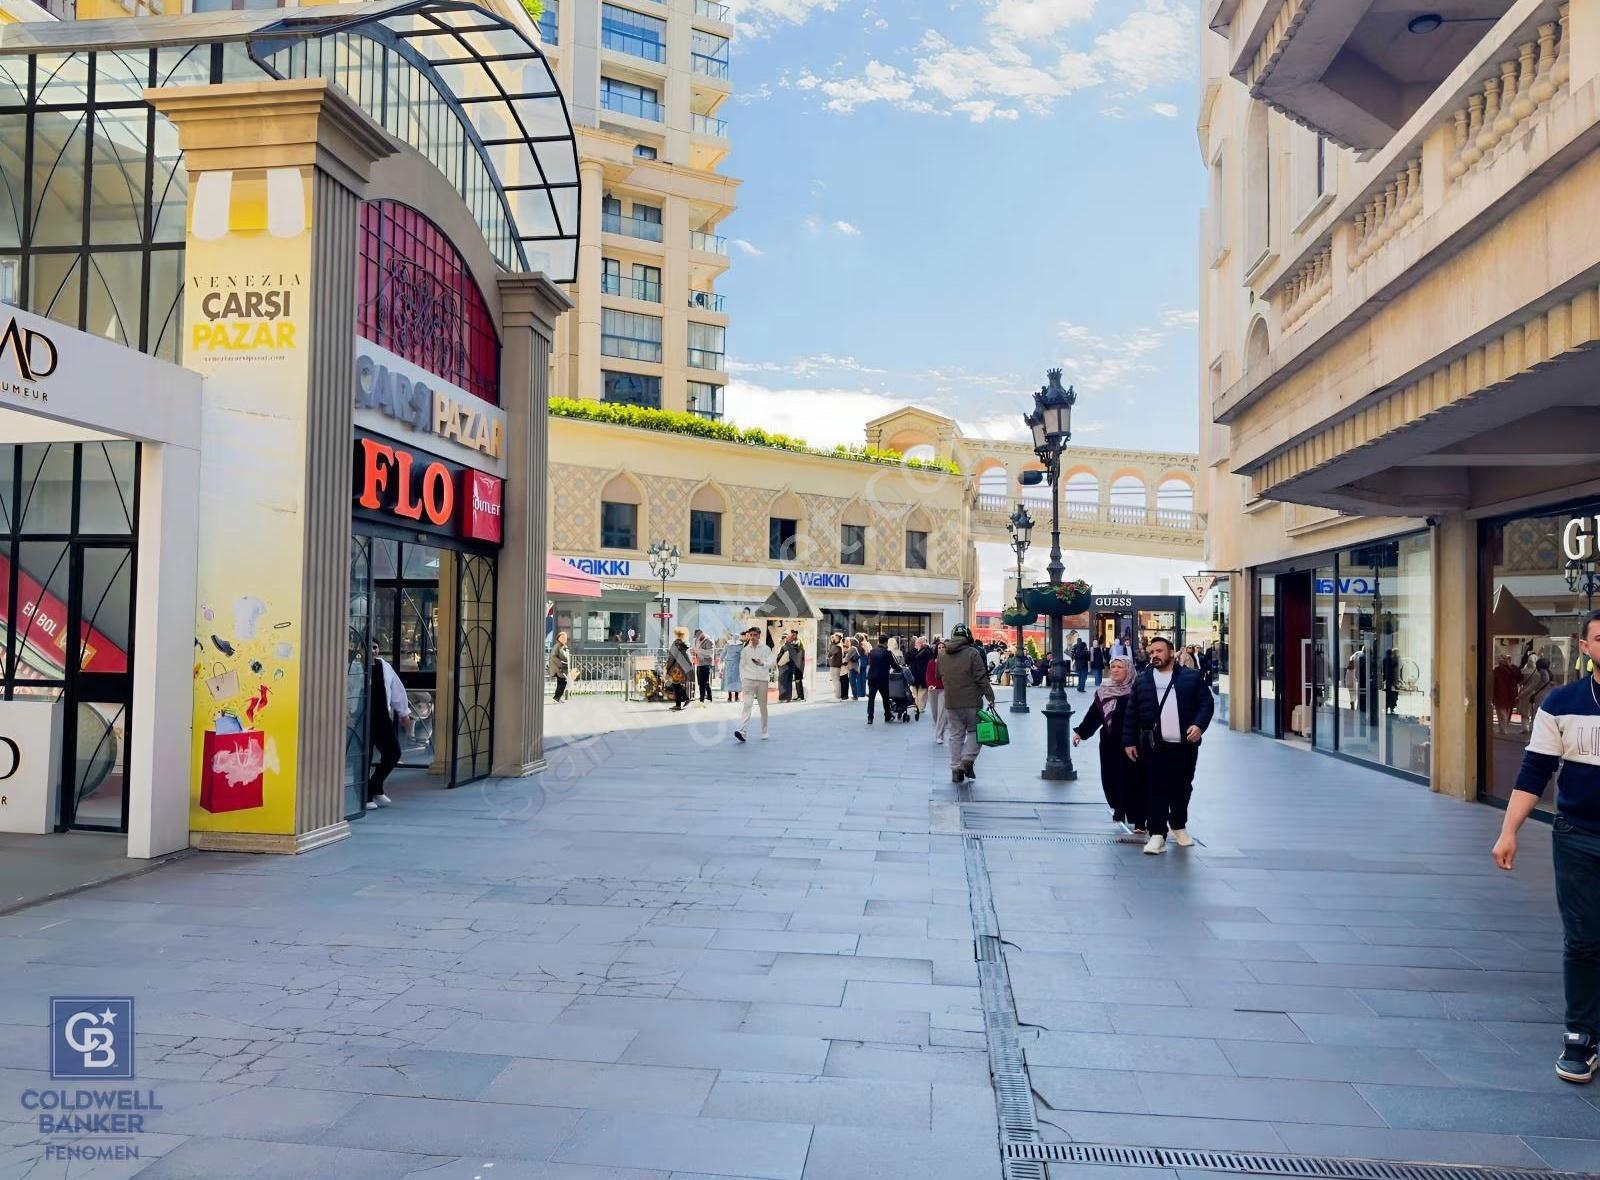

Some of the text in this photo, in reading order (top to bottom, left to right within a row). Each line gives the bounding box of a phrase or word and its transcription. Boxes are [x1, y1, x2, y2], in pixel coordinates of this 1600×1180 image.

[193, 273, 301, 288] VENEZIA
[202, 290, 291, 322] ÇARŞI
[192, 322, 297, 352] PAZAR
[432, 388, 506, 462] PAZAR
[359, 437, 455, 527] FLO
[473, 498, 501, 516] OUTLET
[1095, 597, 1132, 607] GUESS
[36, 612, 57, 637] BOL
